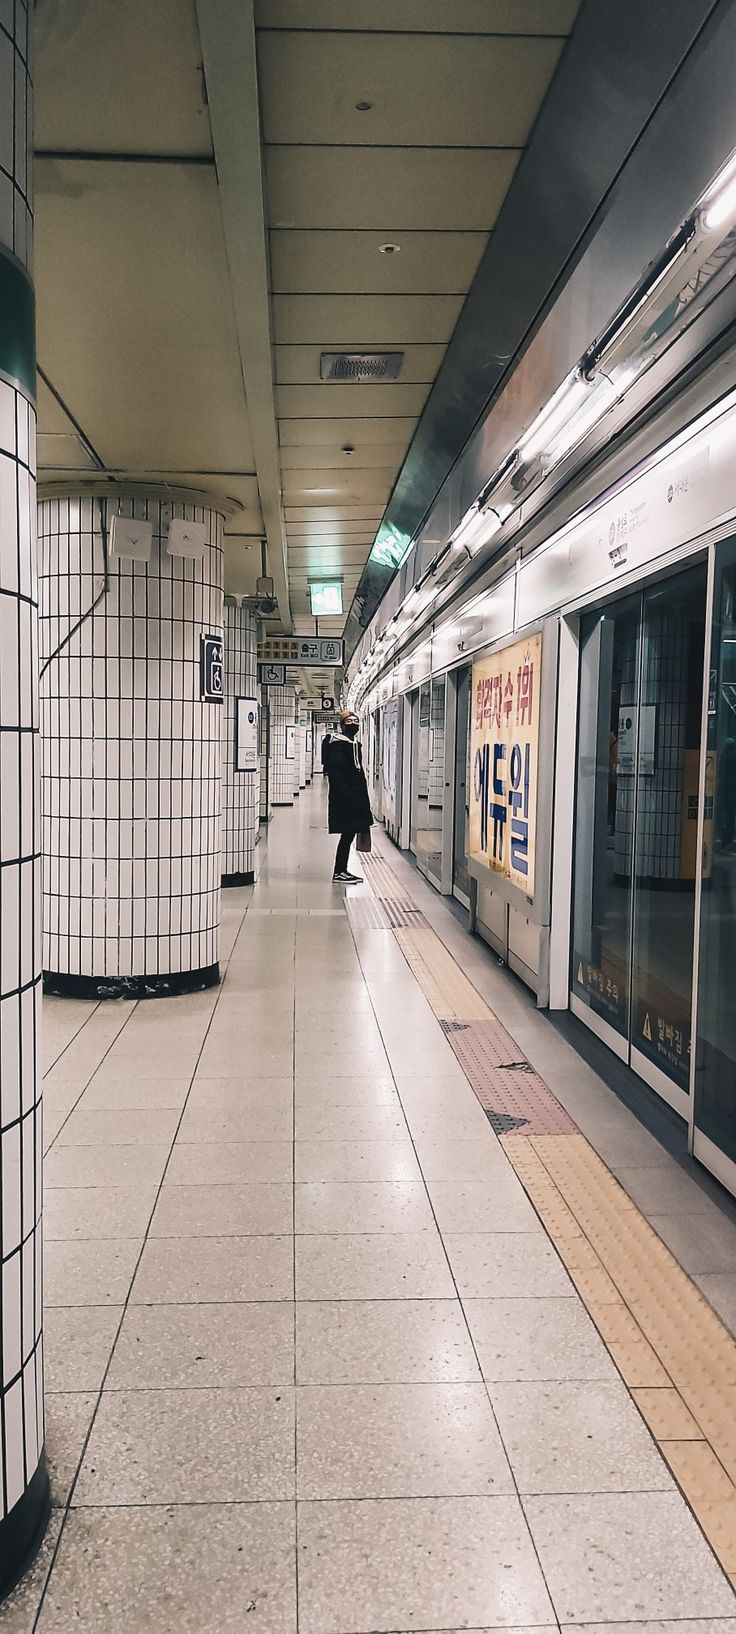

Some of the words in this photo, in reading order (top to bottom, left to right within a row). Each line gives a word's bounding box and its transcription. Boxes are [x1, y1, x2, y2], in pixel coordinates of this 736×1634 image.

[301, 643, 318, 653] 출구
[474, 742, 531, 875] 에듀윌
[606, 978, 619, 1004] 주의
[657, 1016, 683, 1055] 발빠짐
